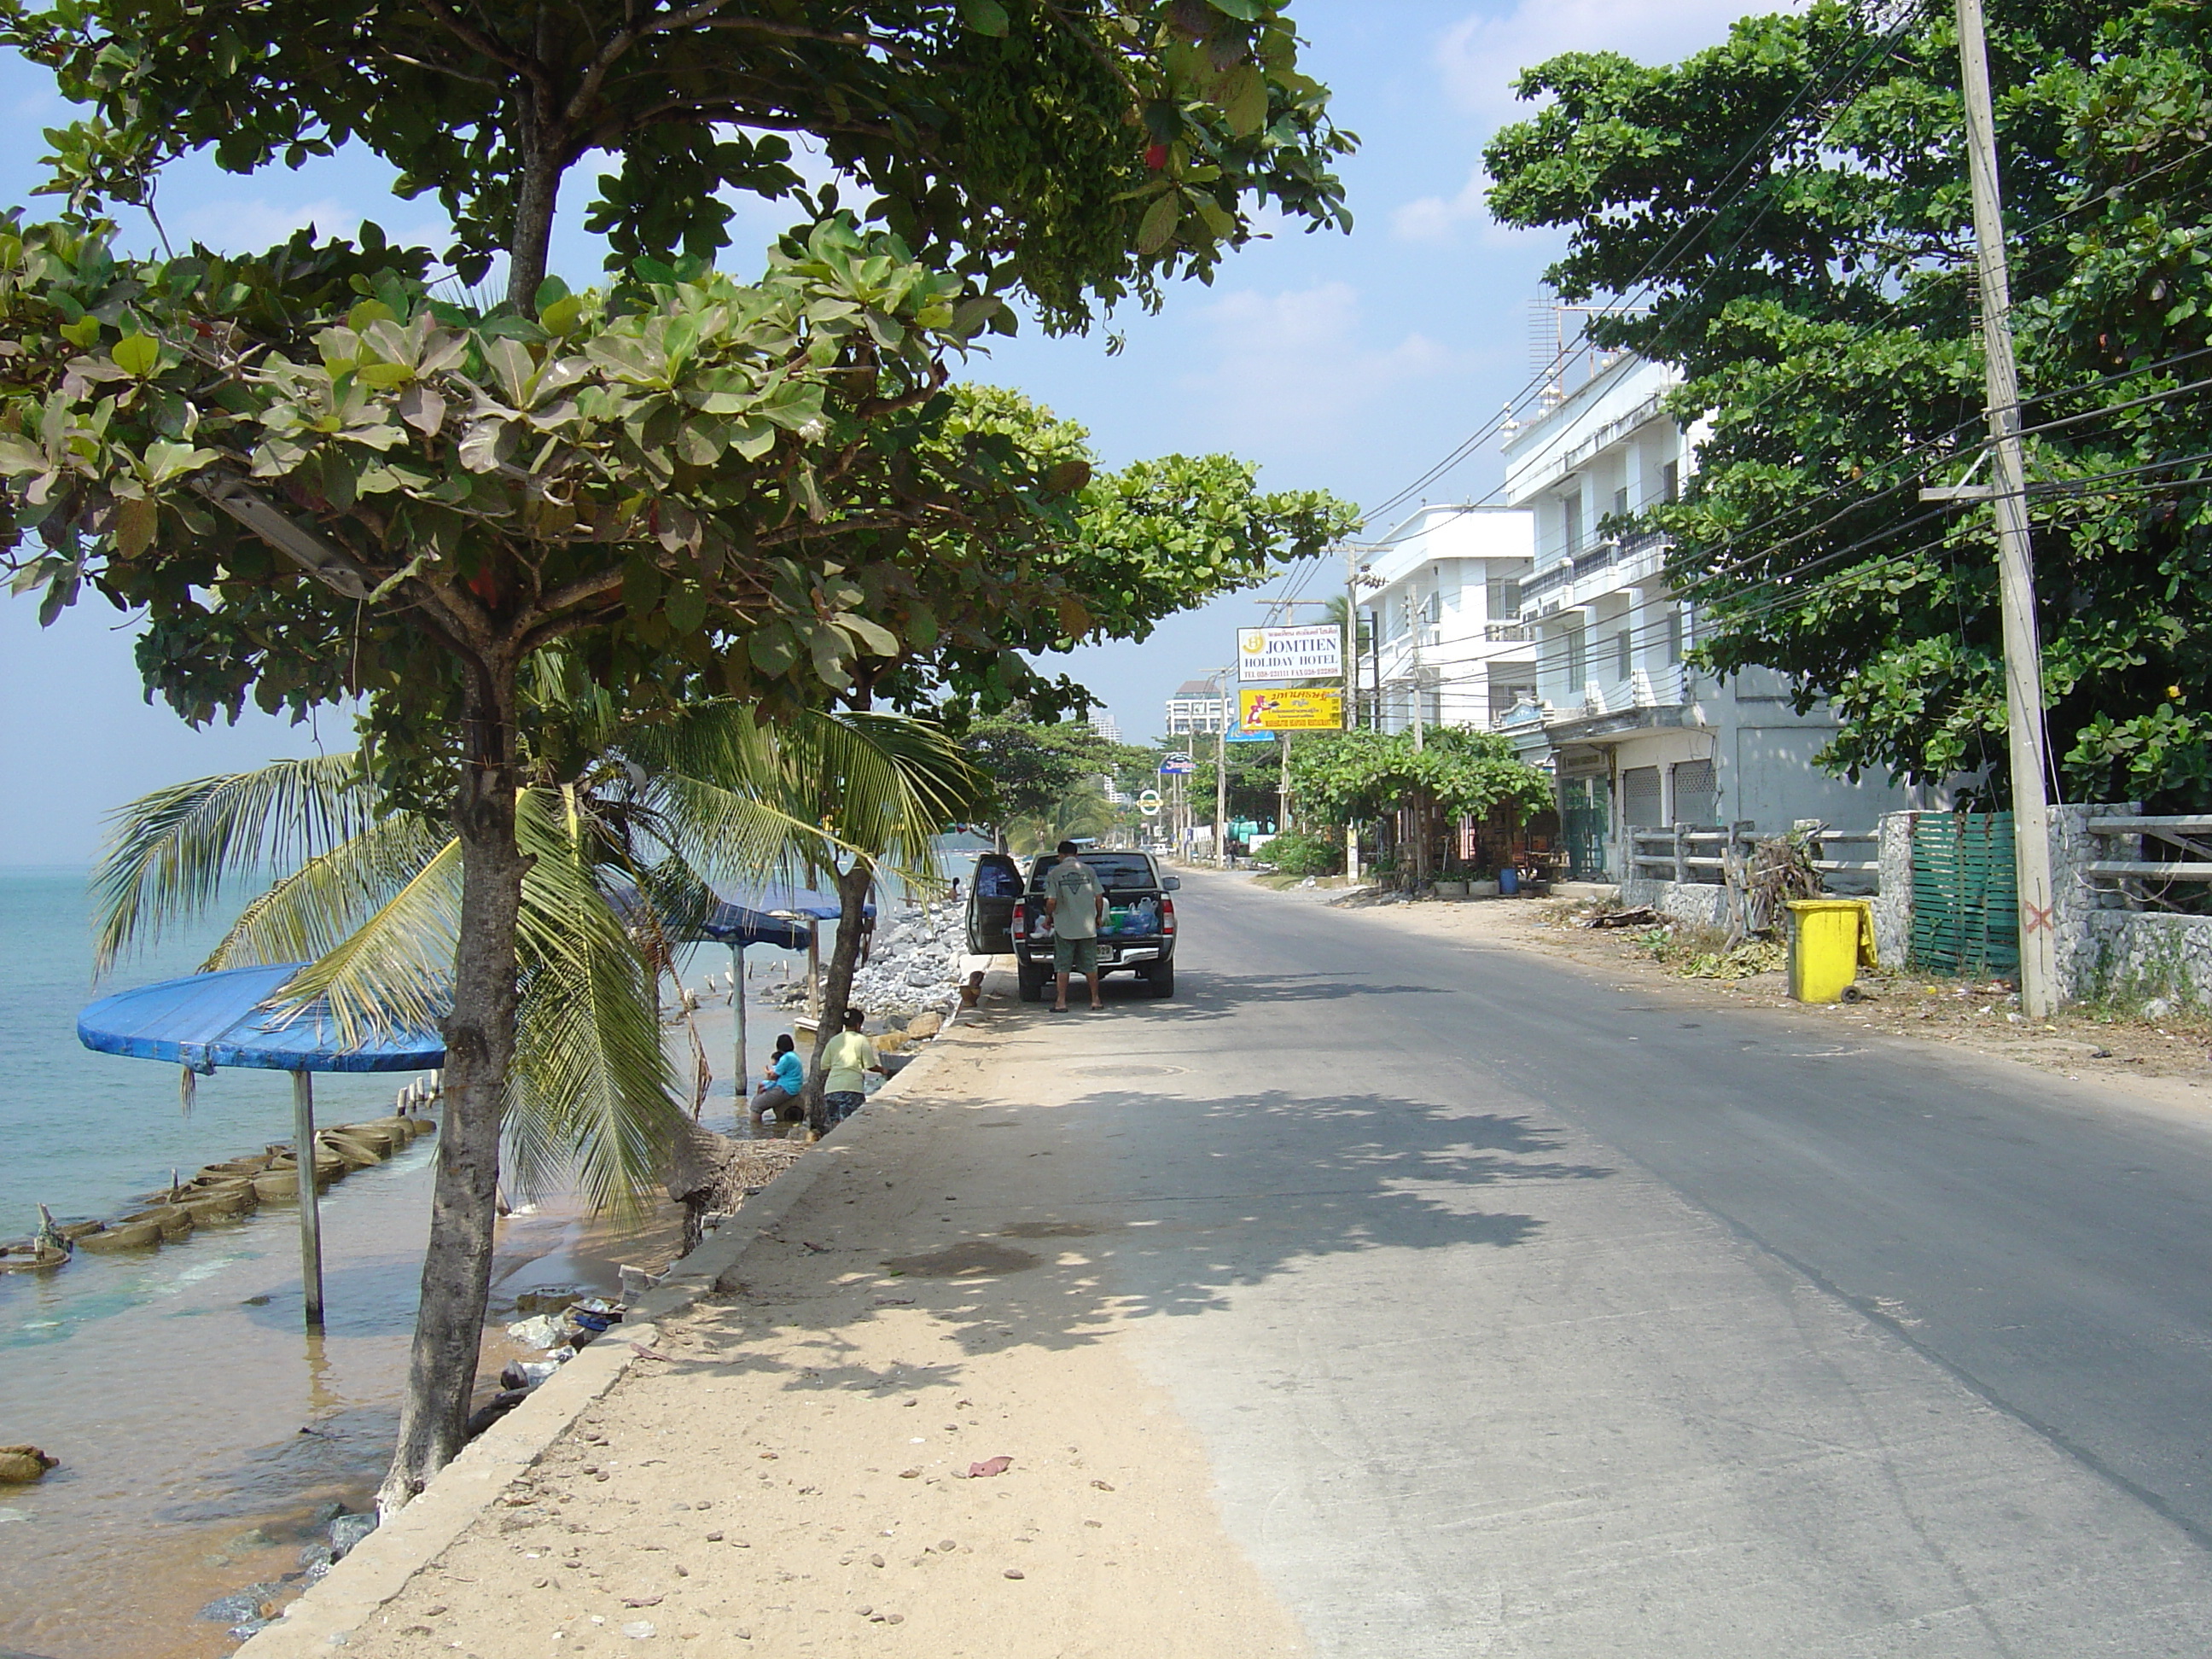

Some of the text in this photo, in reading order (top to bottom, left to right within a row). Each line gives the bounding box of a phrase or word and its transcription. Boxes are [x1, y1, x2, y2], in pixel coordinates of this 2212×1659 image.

[1266, 637, 1336, 655] JOMTIEN
[1245, 655, 1338, 667] HOLIDAY HOTEL
